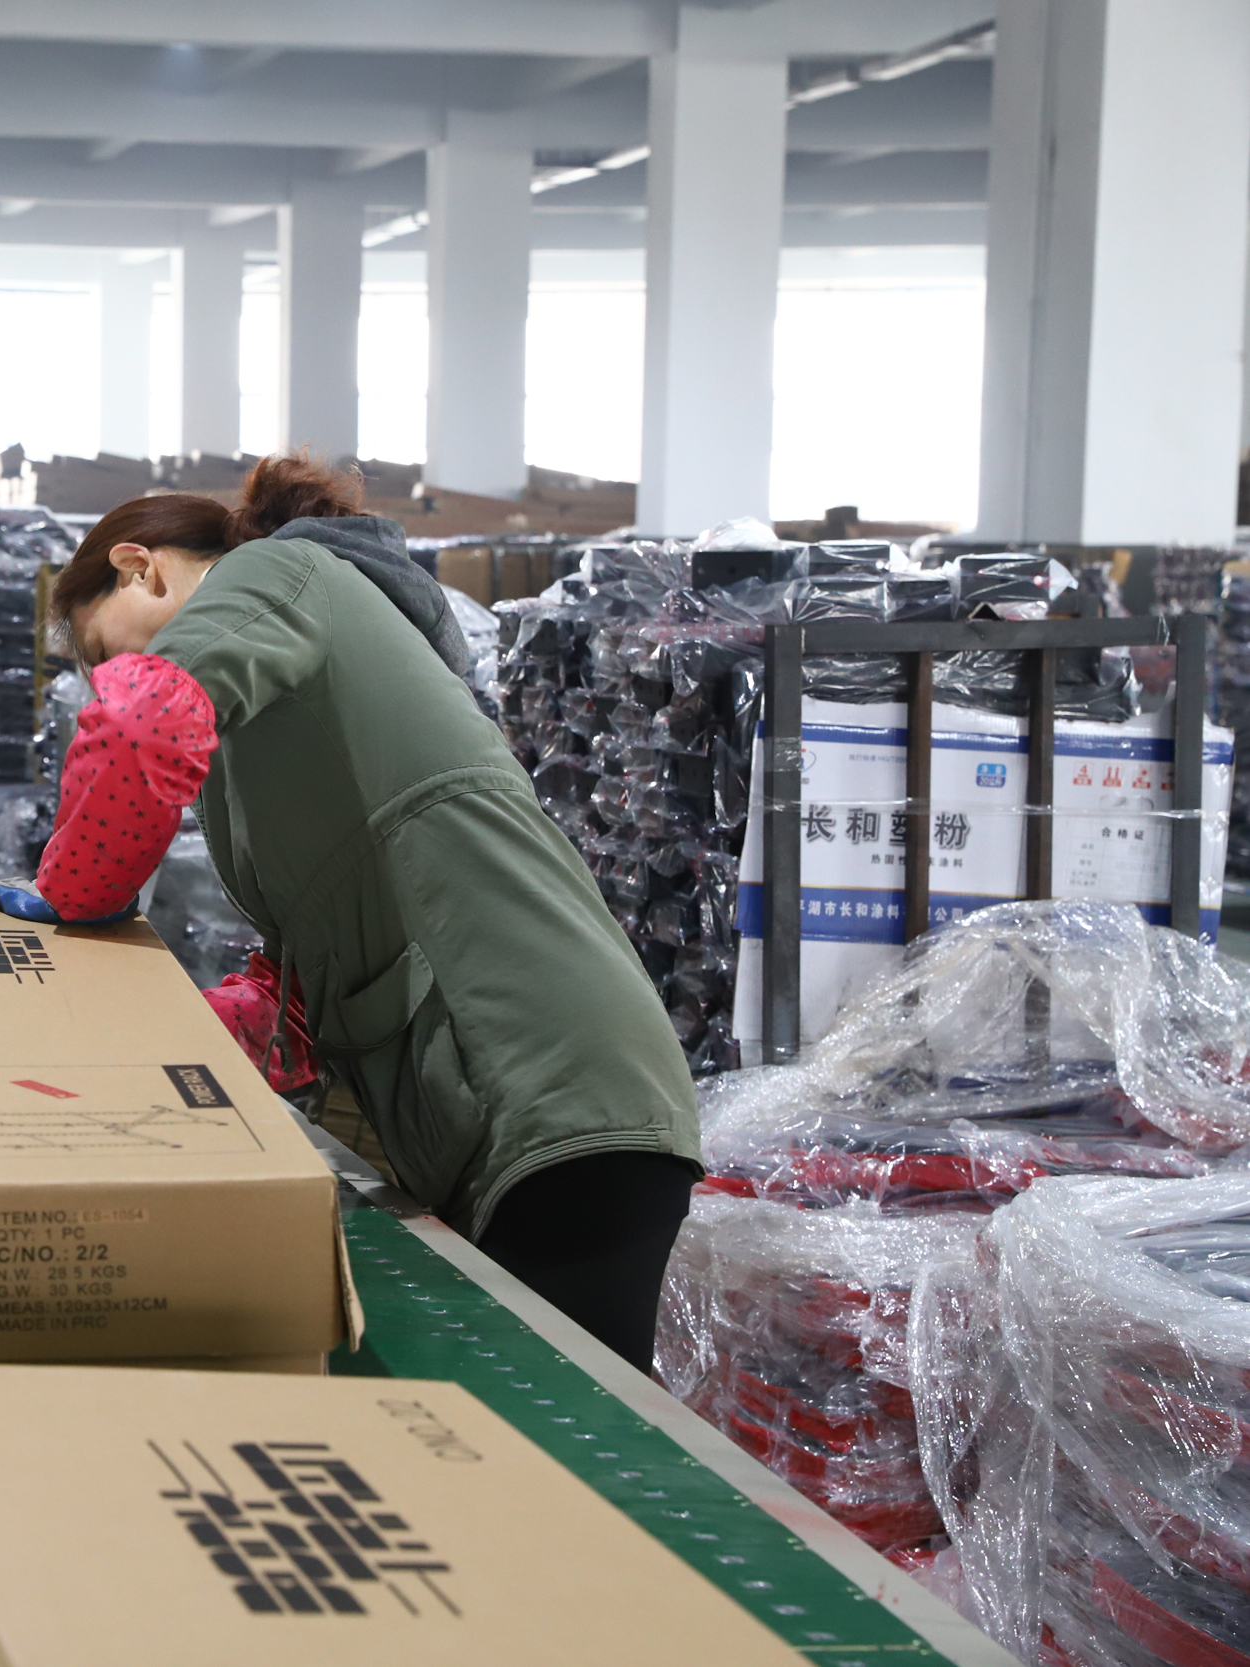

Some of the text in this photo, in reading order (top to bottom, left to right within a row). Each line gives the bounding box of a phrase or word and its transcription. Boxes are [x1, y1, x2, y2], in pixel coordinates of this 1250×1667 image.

[1101, 827, 1145, 841] 合格证
[45, 1228, 52, 1241] 1
[61, 1226, 86, 1240] PC
[76, 1244, 108, 1261] 2/2
[91, 1264, 127, 1278] KGS
[48, 1283, 69, 1297] 30
[77, 1282, 113, 1295] KGS
[51, 1316, 67, 1330] IN
